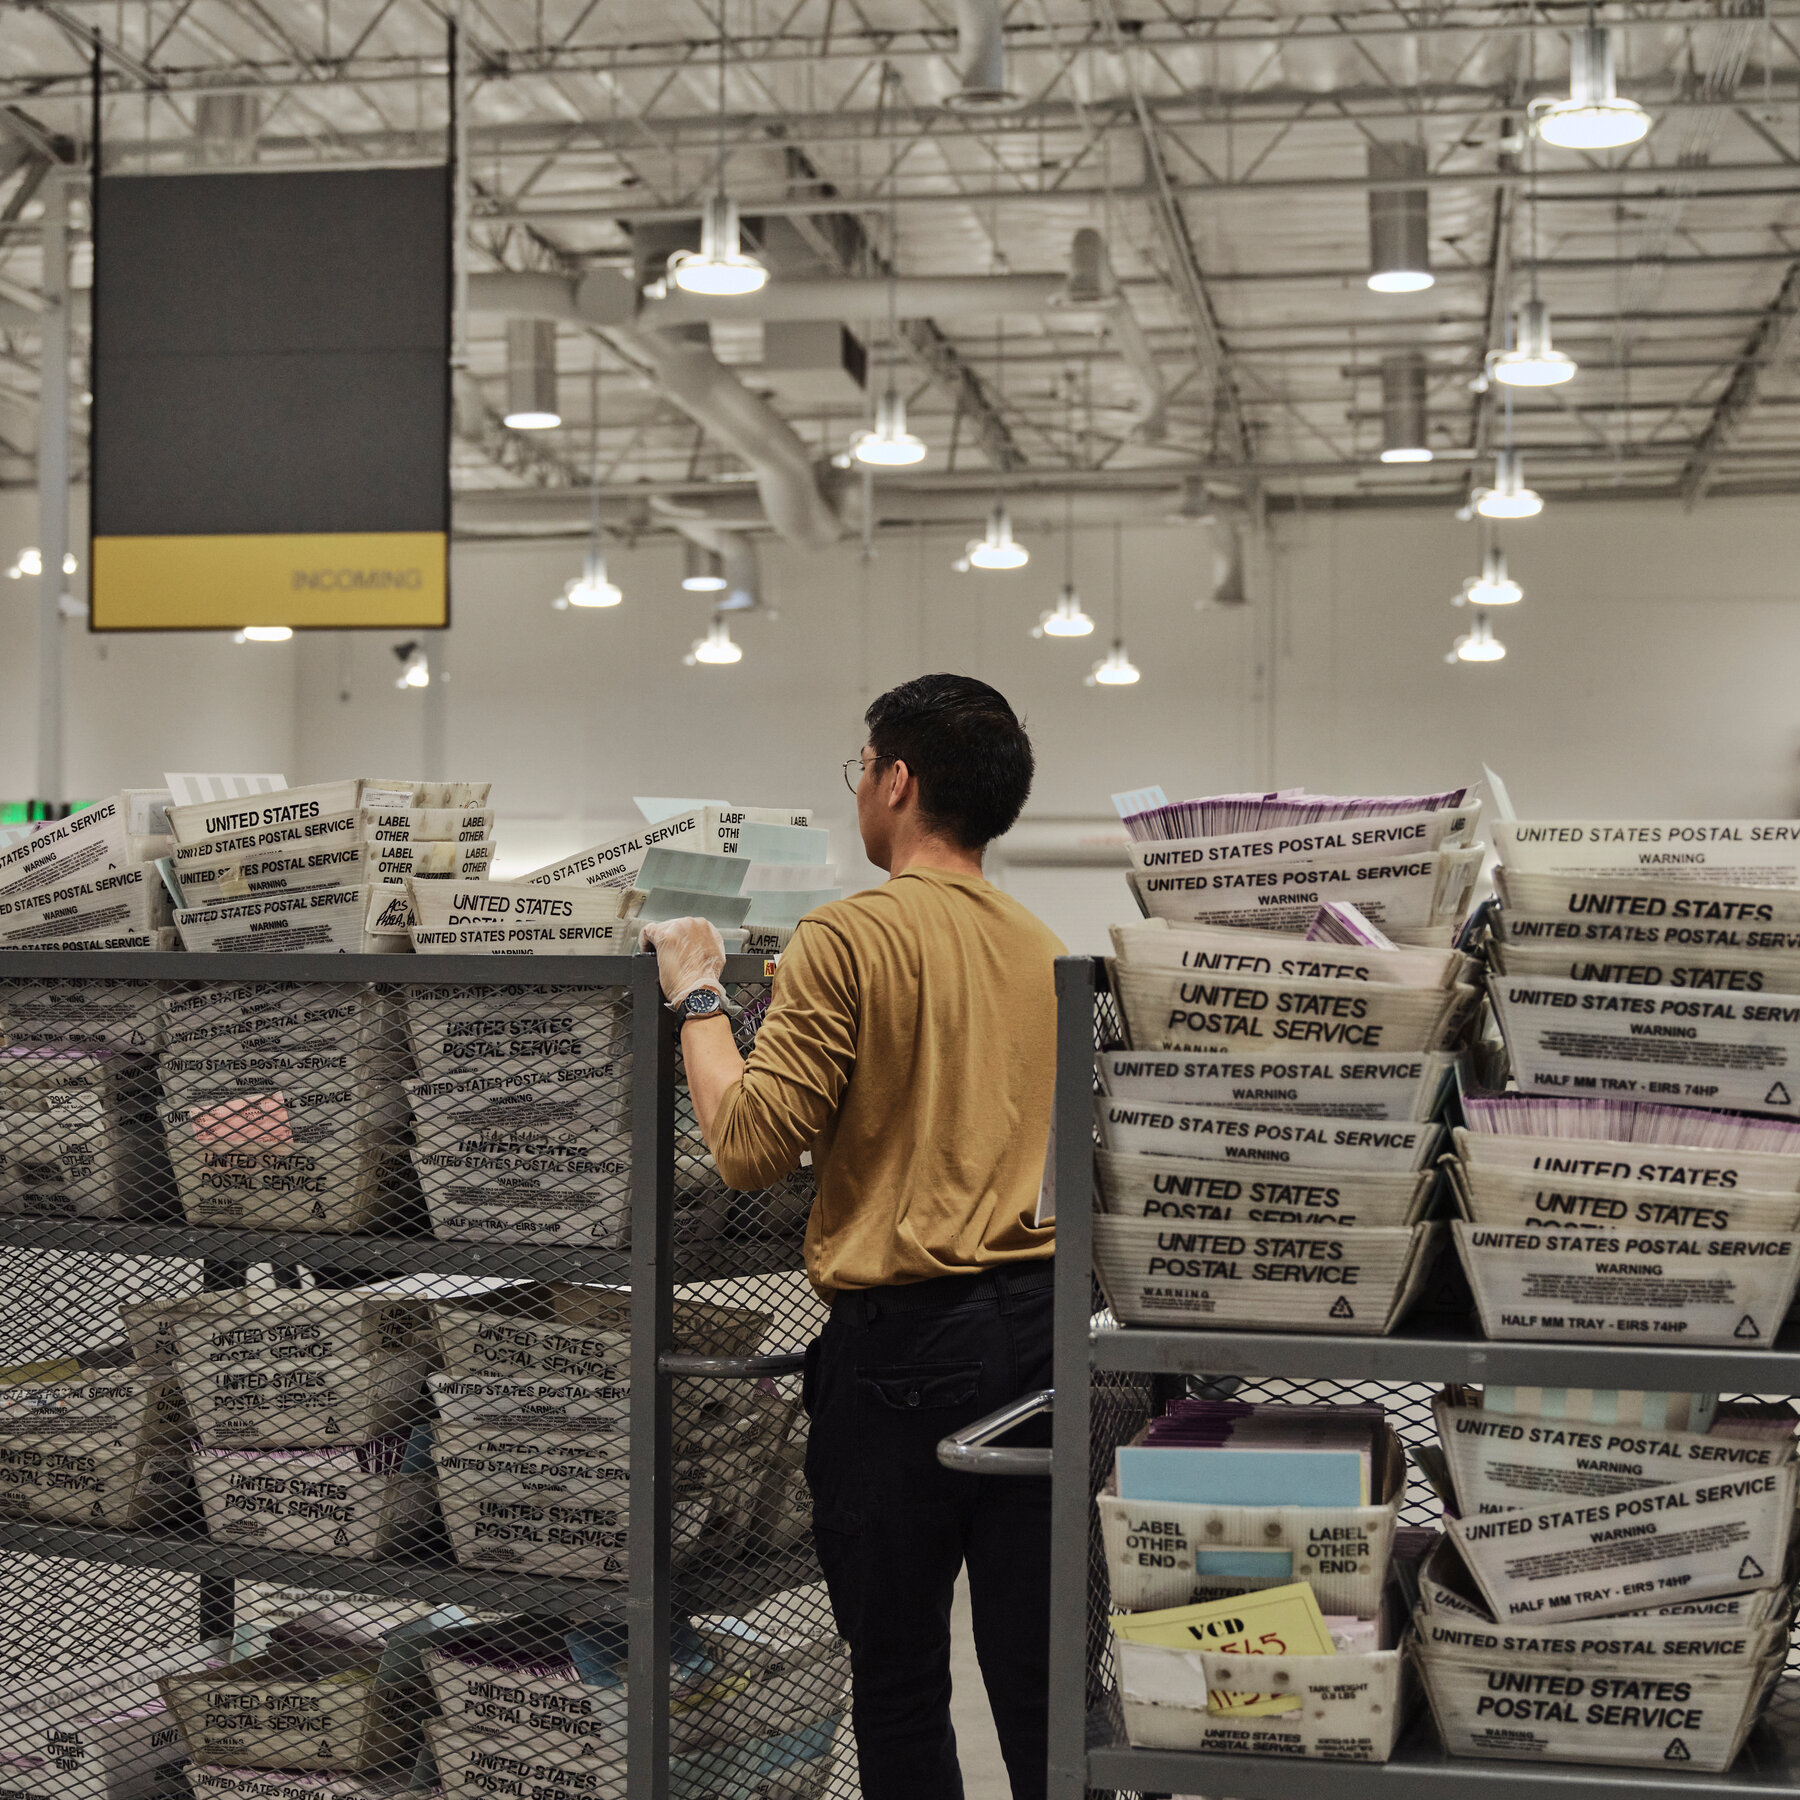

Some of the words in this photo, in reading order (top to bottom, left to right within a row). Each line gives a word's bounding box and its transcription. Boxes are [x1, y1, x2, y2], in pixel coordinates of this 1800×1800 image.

[291, 569, 422, 591] INCOMING
[206, 812, 259, 833] UNITED
[263, 801, 319, 824] STATES
[379, 816, 410, 827] LABEL
[31, 827, 69, 852] POSTAL
[71, 804, 116, 832] SERVICE
[376, 831, 409, 841] OTHER
[459, 831, 483, 841] OTHER
[1516, 828, 1583, 842] UNITED
[1590, 828, 1662, 842] STATES
[1669, 828, 1742, 842] POSTAL
[382, 848, 413, 858] LABEL
[553, 857, 595, 881] STATES
[598, 840, 642, 864] POSTAL
[645, 818, 695, 845] SERVICE
[1144, 849, 1203, 867] UNITED
[1208, 844, 1272, 861] STATES
[1279, 836, 1346, 854] POSTAL
[1352, 825, 1426, 845] SERVICE
[23, 853, 57, 873] WARNING
[379, 862, 412, 873] OTHER
[462, 863, 486, 873] OTHER
[1639, 854, 1706, 864] WARNING
[587, 864, 626, 885] WARNING
[1148, 877, 1207, 891] UNITED
[1212, 873, 1278, 888] STATES
[1283, 869, 1351, 885] POSTAL
[1357, 863, 1432, 879] SERVICE
[15, 895, 50, 911] STATES
[54, 884, 93, 901] POSTAL
[96, 871, 142, 890] SERVICE
[1258, 893, 1318, 905] WARNING
[43, 906, 78, 920] WARNING
[181, 910, 218, 924] UNITED
[221, 903, 261, 919] STATES
[265, 897, 307, 914] POSTAL
[311, 891, 359, 907] SERVICE
[453, 894, 510, 912] UNITED
[515, 898, 572, 916] STATES
[250, 919, 288, 931] WARNING
[417, 932, 456, 944] UNITED
[460, 931, 505, 942] STATES
[509, 929, 555, 941] POSTAL
[559, 927, 612, 939] SERVICE
[1181, 983, 1268, 1010] UNITED
[1276, 992, 1367, 1018] STATES
[1509, 989, 1577, 1008] UNITED
[1581, 994, 1655, 1014] STATES
[1661, 1000, 1736, 1019] POSTAL
[1168, 1011, 1262, 1037] POSTAL
[1273, 1020, 1382, 1047] SERVICE
[1630, 1024, 1696, 1038] WARNING
[1113, 1062, 1179, 1077] UNITED
[1184, 1063, 1254, 1078] STATES
[1261, 1064, 1332, 1079] POSTAL
[1340, 1064, 1422, 1079] SERVICE
[1534, 1073, 1570, 1086] HALF
[1574, 1076, 1596, 1088] MM
[1601, 1078, 1637, 1090] TRAY
[1649, 1082, 1681, 1094] EIRS
[1685, 1084, 1718, 1096] 74HP
[1232, 1089, 1297, 1100] WARNING
[1109, 1108, 1174, 1129] UNITED
[1179, 1118, 1249, 1137] STATES
[1254, 1124, 1328, 1143] POSTAL
[1335, 1131, 1416, 1149] SERVICE
[204, 1153, 256, 1169] UNITED
[263, 1156, 315, 1170] STATES
[422, 1154, 462, 1166] UNITED
[465, 1157, 510, 1170] STATES
[514, 1159, 564, 1172] POSTAL
[567, 1161, 624, 1173] SERVICE
[1225, 1147, 1289, 1161] WARNING
[201, 1173, 256, 1190] POSTAL
[262, 1175, 326, 1192] SERVICE
[1154, 1174, 1241, 1200] UNITED
[1250, 1182, 1340, 1207] STATES
[1536, 1193, 1627, 1219] UNITED
[1635, 1204, 1729, 1230] STATES
[1158, 1232, 1245, 1256] UNITED
[1253, 1238, 1343, 1260] STATES
[1472, 1232, 1540, 1250] UNITED
[1546, 1236, 1619, 1252] STATES
[1626, 1239, 1700, 1254] POSTAL
[1707, 1241, 1792, 1256] SERVICE
[1149, 1257, 1243, 1280] POSTAL
[1252, 1262, 1360, 1285] SERVICE
[1596, 1263, 1662, 1275] WARNING
[1143, 1287, 1210, 1298] WARNING
[1501, 1314, 1537, 1326] HALF
[1541, 1316, 1564, 1328] MM
[1568, 1318, 1604, 1329] TRAY
[1617, 1319, 1648, 1331] EIRS
[1653, 1321, 1687, 1332] 74HP
[1456, 1419, 1523, 1440] UNITED
[1529, 1429, 1601, 1449] STATES
[1607, 1437, 1682, 1458] POSTAL
[1689, 1445, 1771, 1465] SERVICE
[1576, 1459, 1642, 1475] WARNING
[230, 1474, 285, 1493] UNITED
[289, 1480, 347, 1500] STATES
[225, 1494, 284, 1514] POSTAL
[288, 1501, 355, 1522] SERVICE
[479, 1502, 544, 1521] UNITED
[549, 1506, 617, 1526] STATES
[1466, 1518, 1532, 1541] UNITED
[1538, 1507, 1609, 1531] STATES
[1616, 1493, 1690, 1517] POSTAL
[1696, 1476, 1776, 1503] SERVICE
[475, 1522, 543, 1542] POSTAL
[548, 1528, 627, 1547] SERVICE
[1129, 1521, 1182, 1536] LABEL
[1310, 1527, 1367, 1541] LABEL
[1590, 1523, 1657, 1543] WARNING
[1127, 1536, 1187, 1550] OTHER
[1307, 1543, 1369, 1557] OTHER
[1139, 1553, 1175, 1568] END
[1319, 1560, 1357, 1574] END
[1510, 1600, 1544, 1614] HALF
[1548, 1596, 1572, 1608] MM
[1576, 1589, 1610, 1604] TRAY
[1623, 1580, 1655, 1596] EIRS
[1658, 1575, 1691, 1589] 74HP
[1187, 1618, 1244, 1640] VCD
[1432, 1627, 1498, 1648] UNITED
[1504, 1637, 1576, 1652] STATES
[1582, 1640, 1657, 1654] POSTAL
[1663, 1640, 1746, 1654] SERVICE
[1333, 1683, 1368, 1692] WEIGHT
[1488, 1672, 1584, 1696] UNITED
[1591, 1678, 1692, 1701] STATES
[468, 1681, 524, 1704] UNITED
[529, 1693, 591, 1715] STATES
[1477, 1697, 1579, 1722] POSTAL
[1587, 1705, 1702, 1729] SERVICE
[1204, 1730, 1250, 1739] UNITED
[1252, 1732, 1301, 1742] STATES
[1485, 1729, 1534, 1739] WARNING
[1201, 1739, 1250, 1749] POSTAL
[1252, 1743, 1306, 1754] SERVICE
[56, 1759, 78, 1770] END
